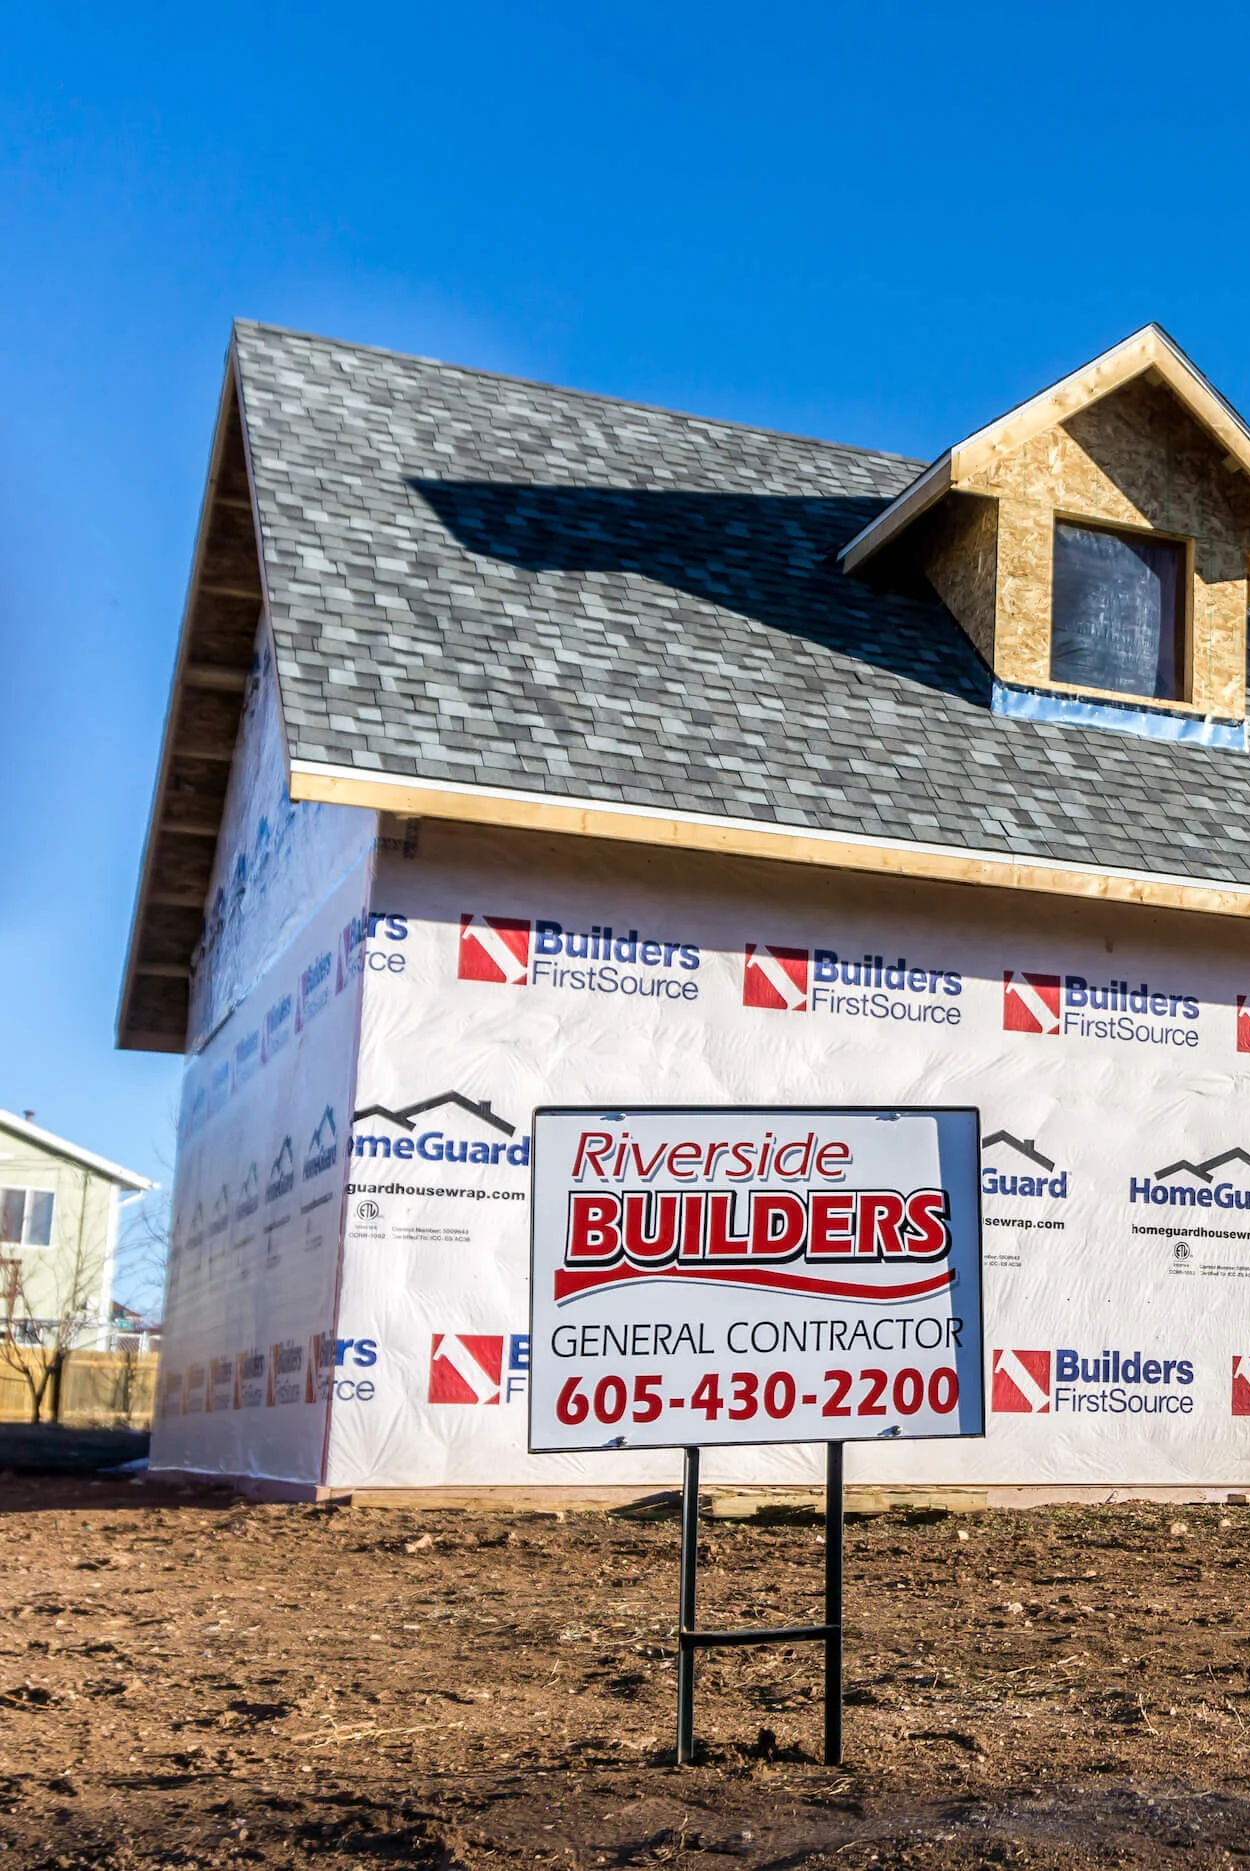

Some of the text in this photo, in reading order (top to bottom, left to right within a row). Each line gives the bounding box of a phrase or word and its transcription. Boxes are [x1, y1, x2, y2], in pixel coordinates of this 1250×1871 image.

[534, 919, 700, 970] Builders
[532, 959, 699, 1001] FirstSource
[813, 948, 962, 996] Builders
[811, 987, 962, 1025] FirstSource
[1064, 975, 1200, 1019] Builders
[1063, 1012, 1200, 1047] FirstSource
[572, 1131, 852, 1181] Riverside
[565, 1190, 951, 1265] BUILDERS
[983, 1217, 1065, 1230] sewrap.com
[551, 1317, 964, 1358] GENERAL CONTRACTOR
[1055, 1349, 1194, 1385] Builders
[556, 1366, 959, 1425] 605-430-2200
[1055, 1388, 1193, 1413] FirstSource
